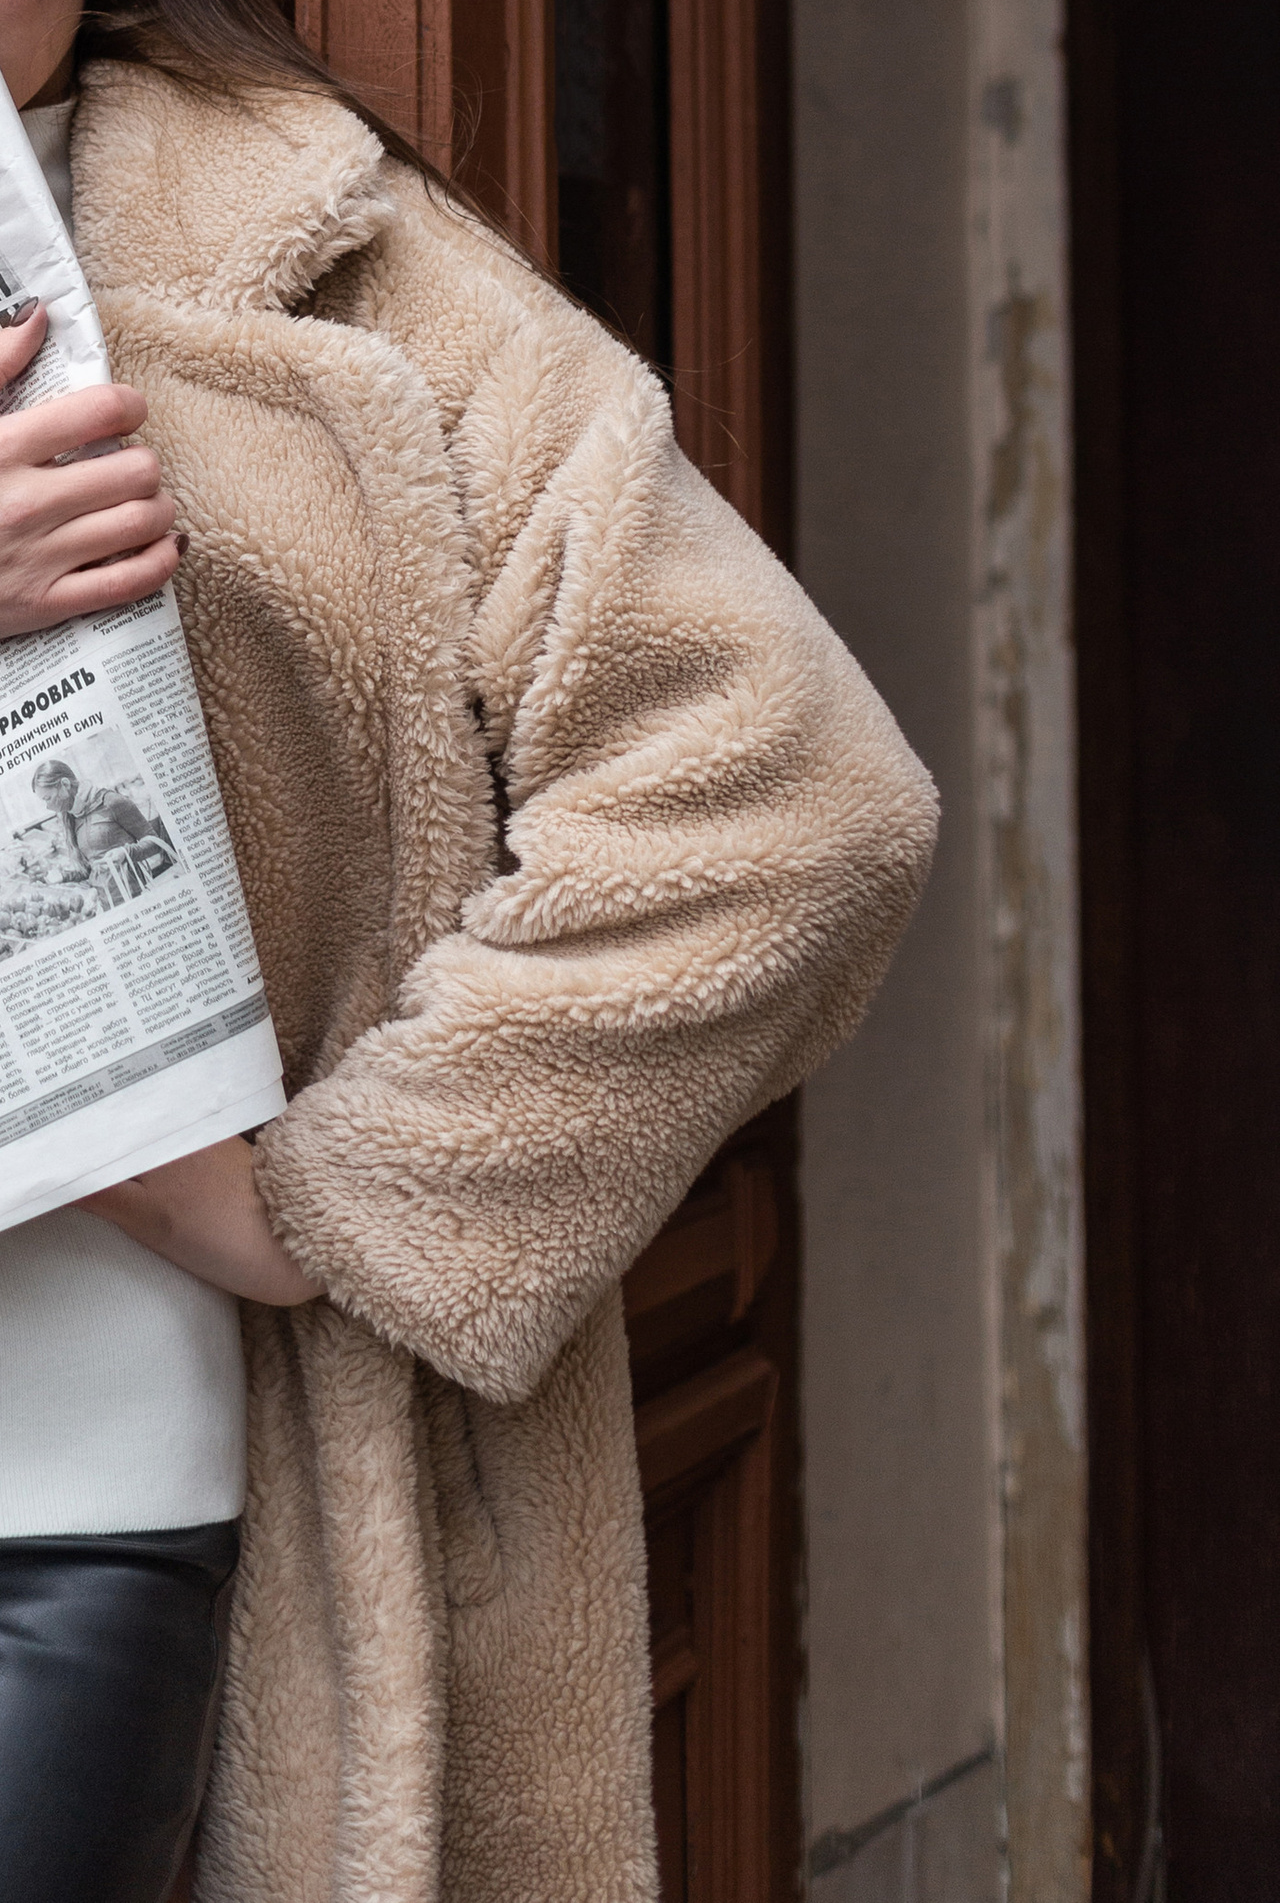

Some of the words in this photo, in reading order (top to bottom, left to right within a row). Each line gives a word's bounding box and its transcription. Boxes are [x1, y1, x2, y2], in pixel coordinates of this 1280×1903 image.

[99, 615, 133, 636] Татьяна
[130, 599, 166, 620] ПЕСИНА.
[5, 733, 61, 770] вступили
[62, 727, 72, 739] в
[73, 710, 104, 733] силу
